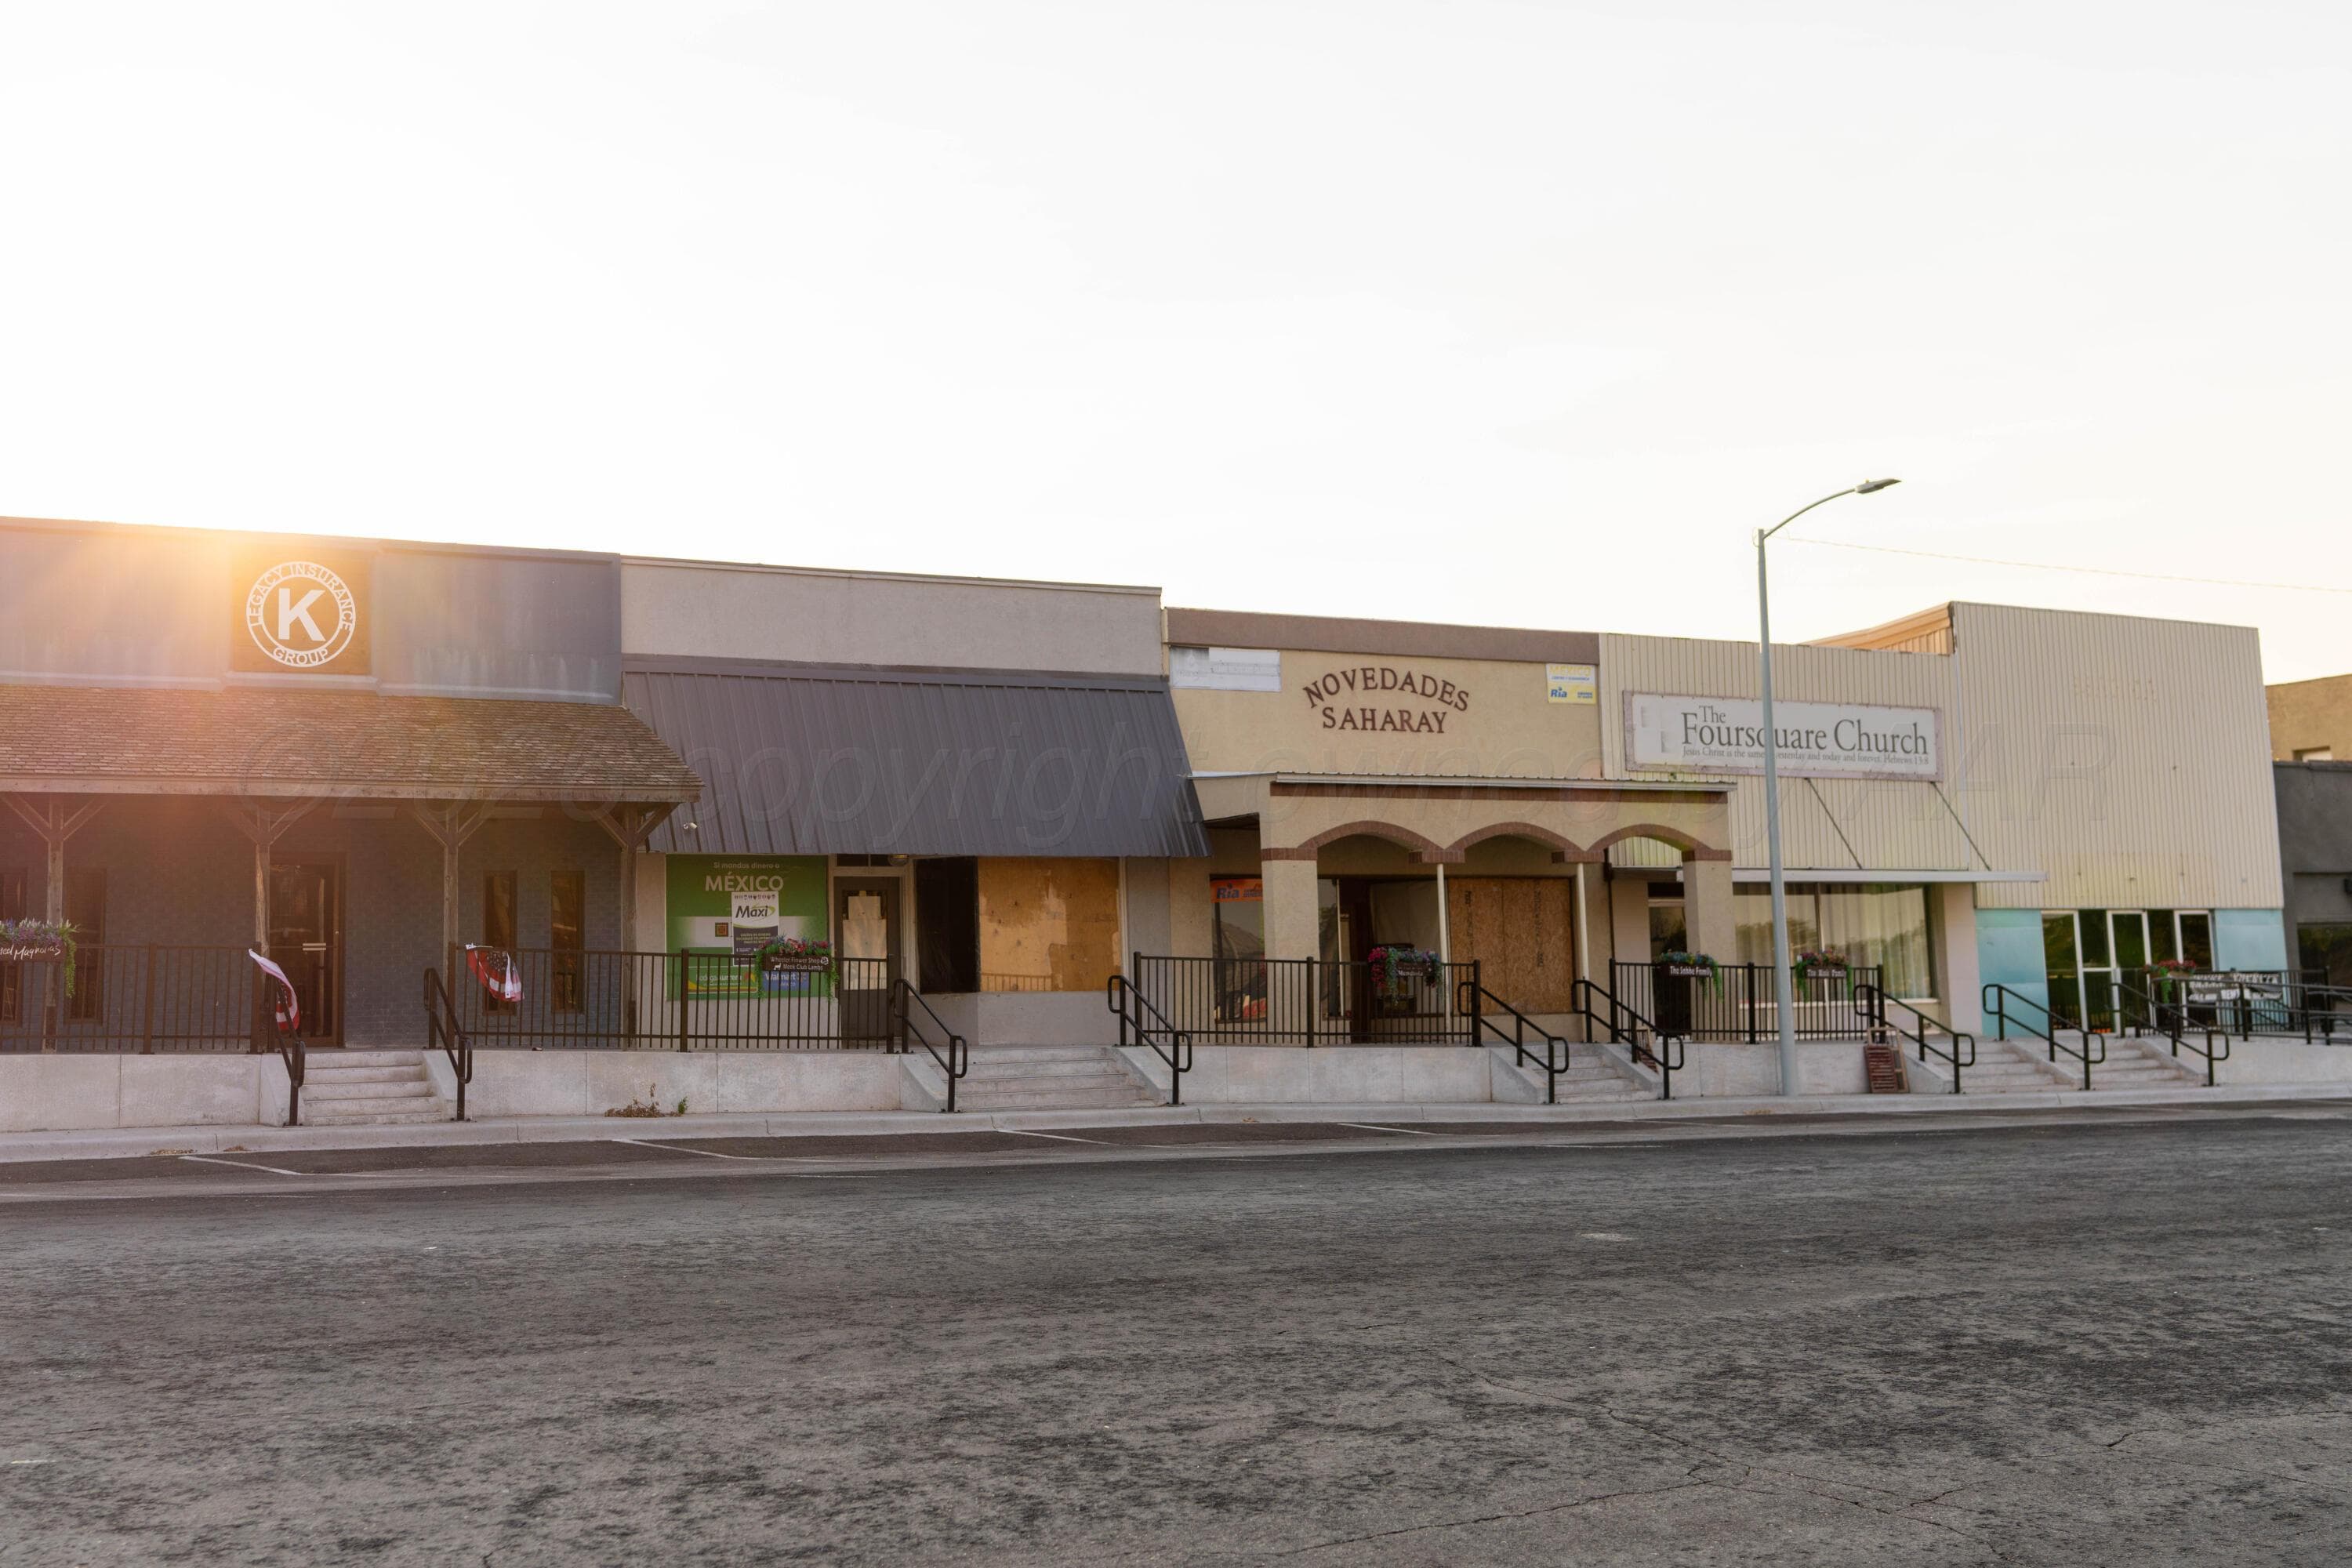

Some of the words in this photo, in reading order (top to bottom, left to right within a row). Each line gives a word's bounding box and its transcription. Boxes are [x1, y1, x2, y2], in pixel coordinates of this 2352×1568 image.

[249, 565, 284, 627] LEGACY
[289, 563, 354, 631] INSURANCE
[278, 588, 326, 641] K
[273, 646, 328, 665] GROUP
[1302, 667, 1469, 712] NOVEDADES
[1550, 686, 1568, 698] Ria
[1322, 706, 1447, 734] SAHARAY
[1698, 705, 1726, 724] The
[1834, 718, 1929, 755] Church
[1702, 746, 1725, 757] Christ
[1734, 749, 1745, 757] the
[1775, 750, 1805, 760] esterday
[1806, 752, 1820, 760] and
[1822, 753, 1841, 762] today
[705, 872, 784, 892] MÉXICO
[1216, 883, 1240, 899] Ria
[735, 905, 768, 919] Maxi
